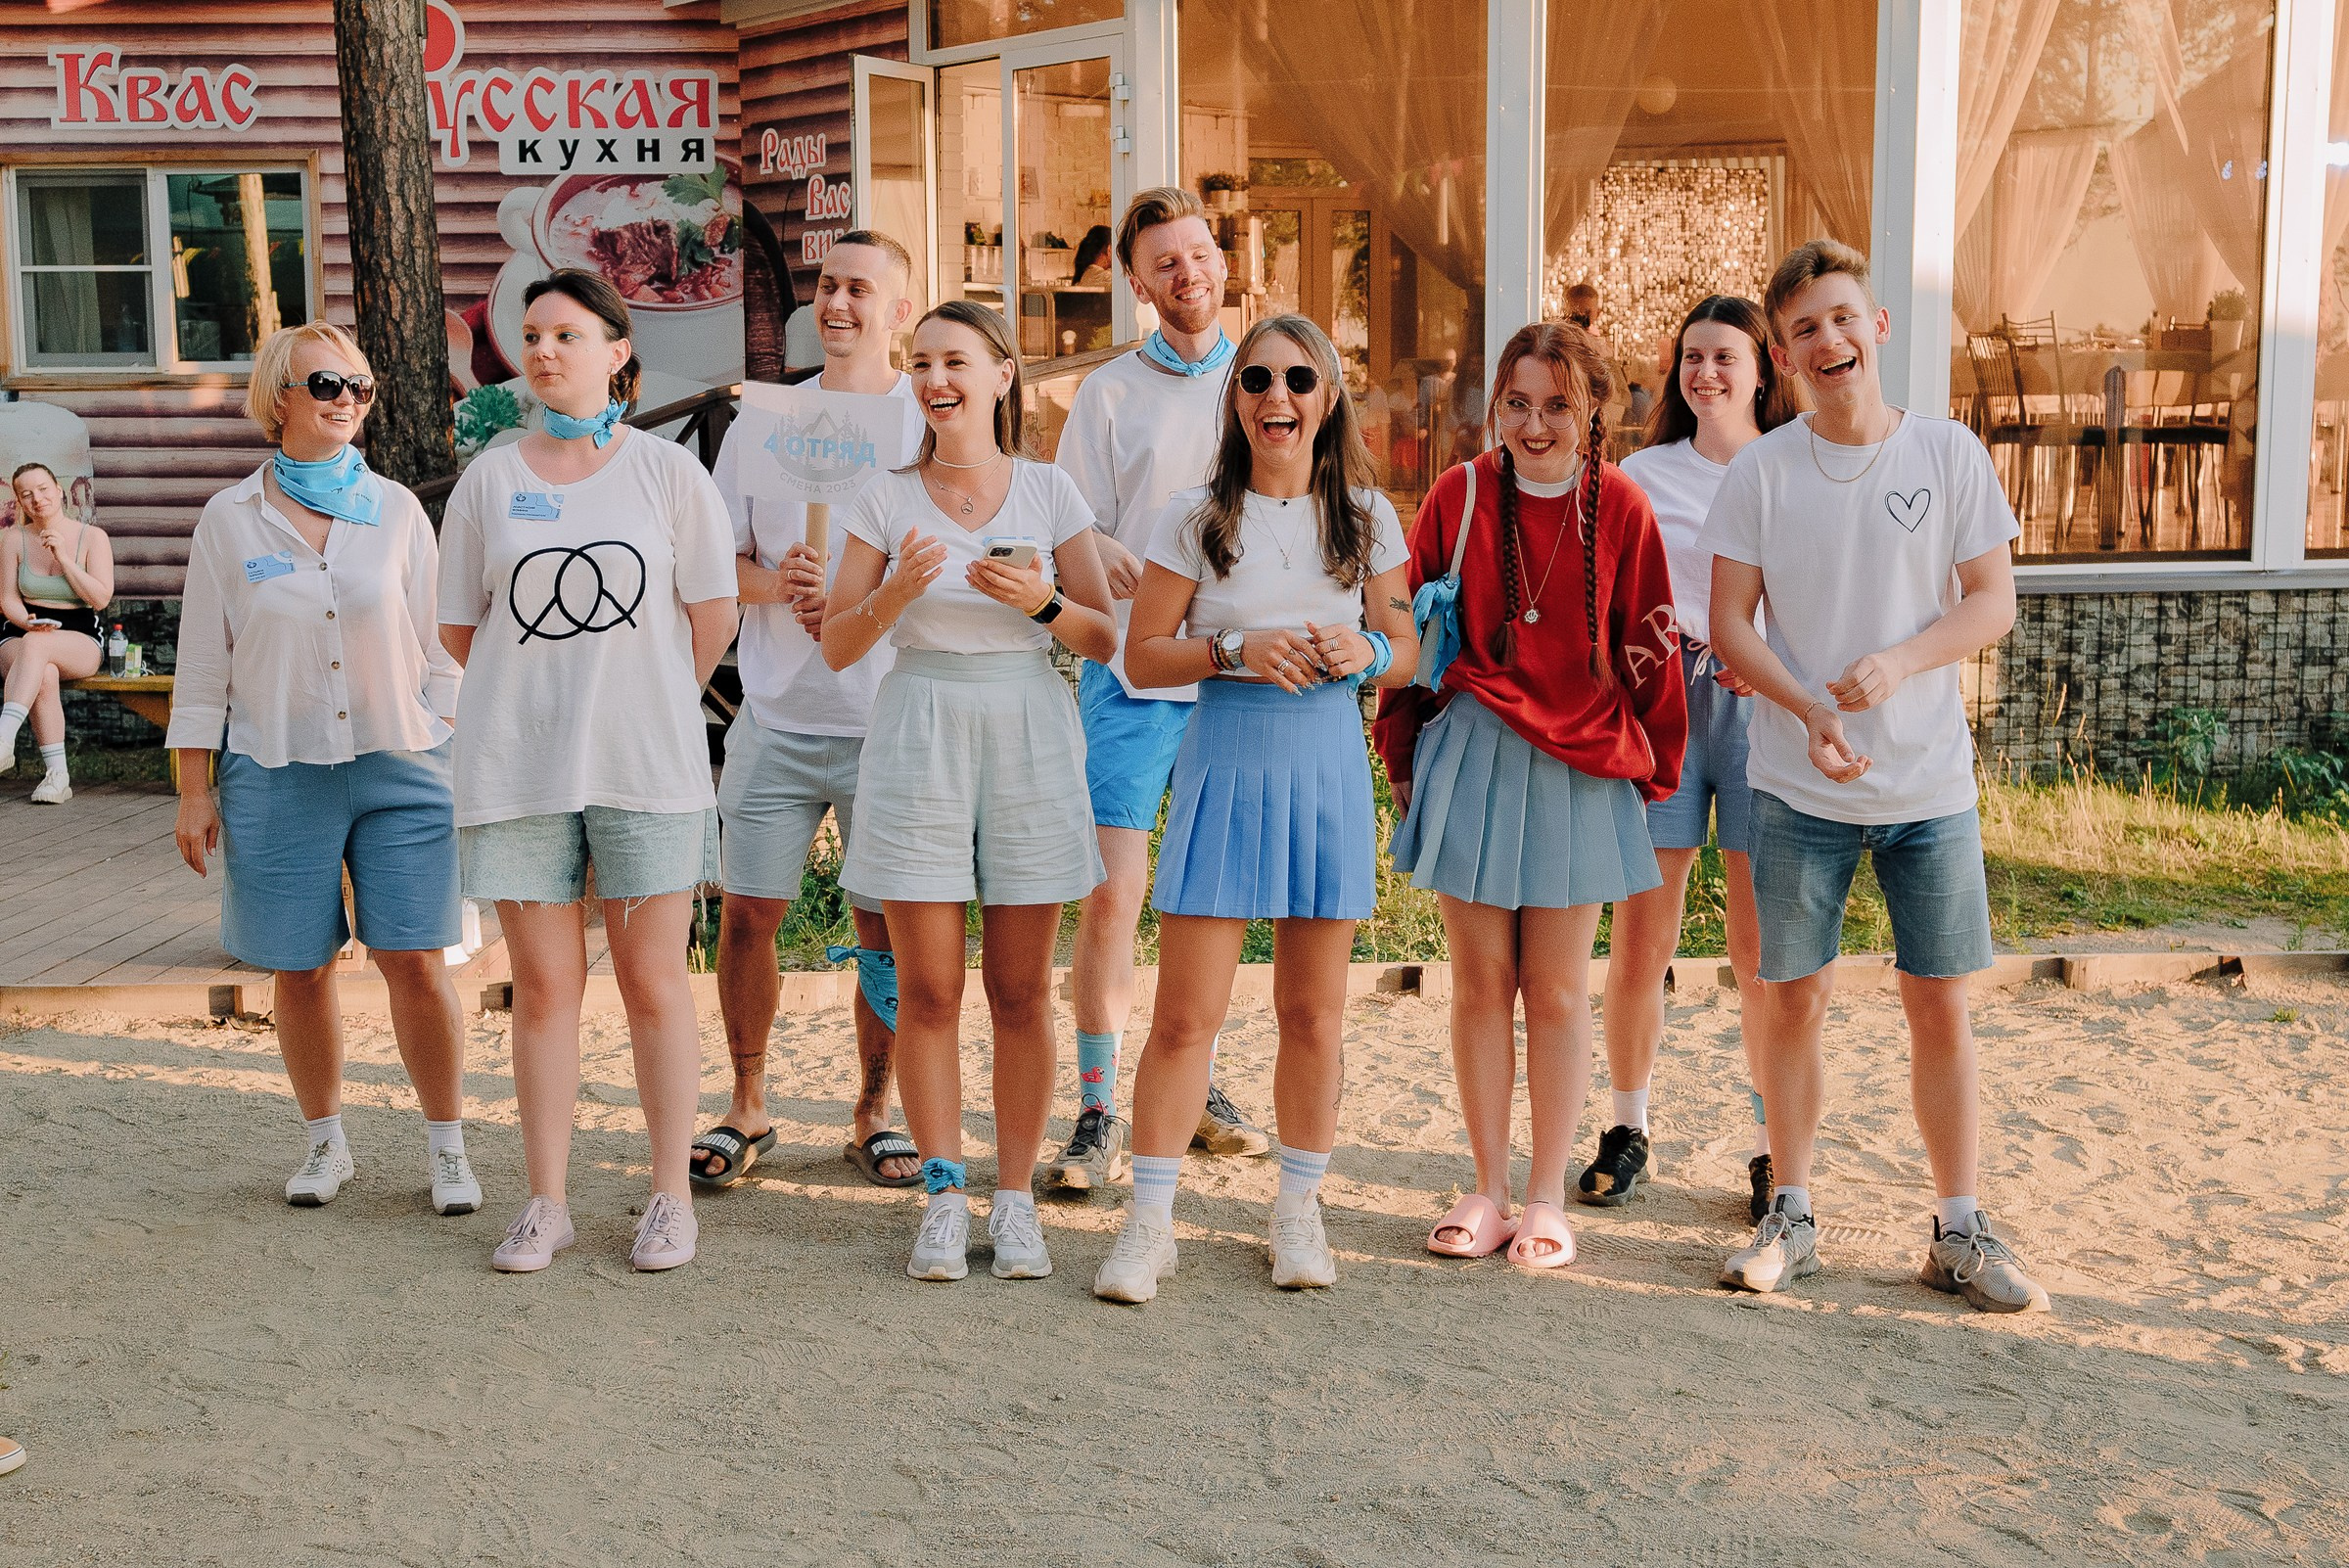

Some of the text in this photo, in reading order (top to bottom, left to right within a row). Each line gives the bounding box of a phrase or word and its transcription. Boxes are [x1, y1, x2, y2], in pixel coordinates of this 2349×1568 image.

[55, 52, 254, 125] Квас
[518, 138, 706, 171] кухня
[761, 132, 825, 177] Рады
[808, 177, 850, 216] Вас
[763, 434, 877, 469] 4 ОТРЯД
[779, 472, 856, 494] СМЕНА 2023
